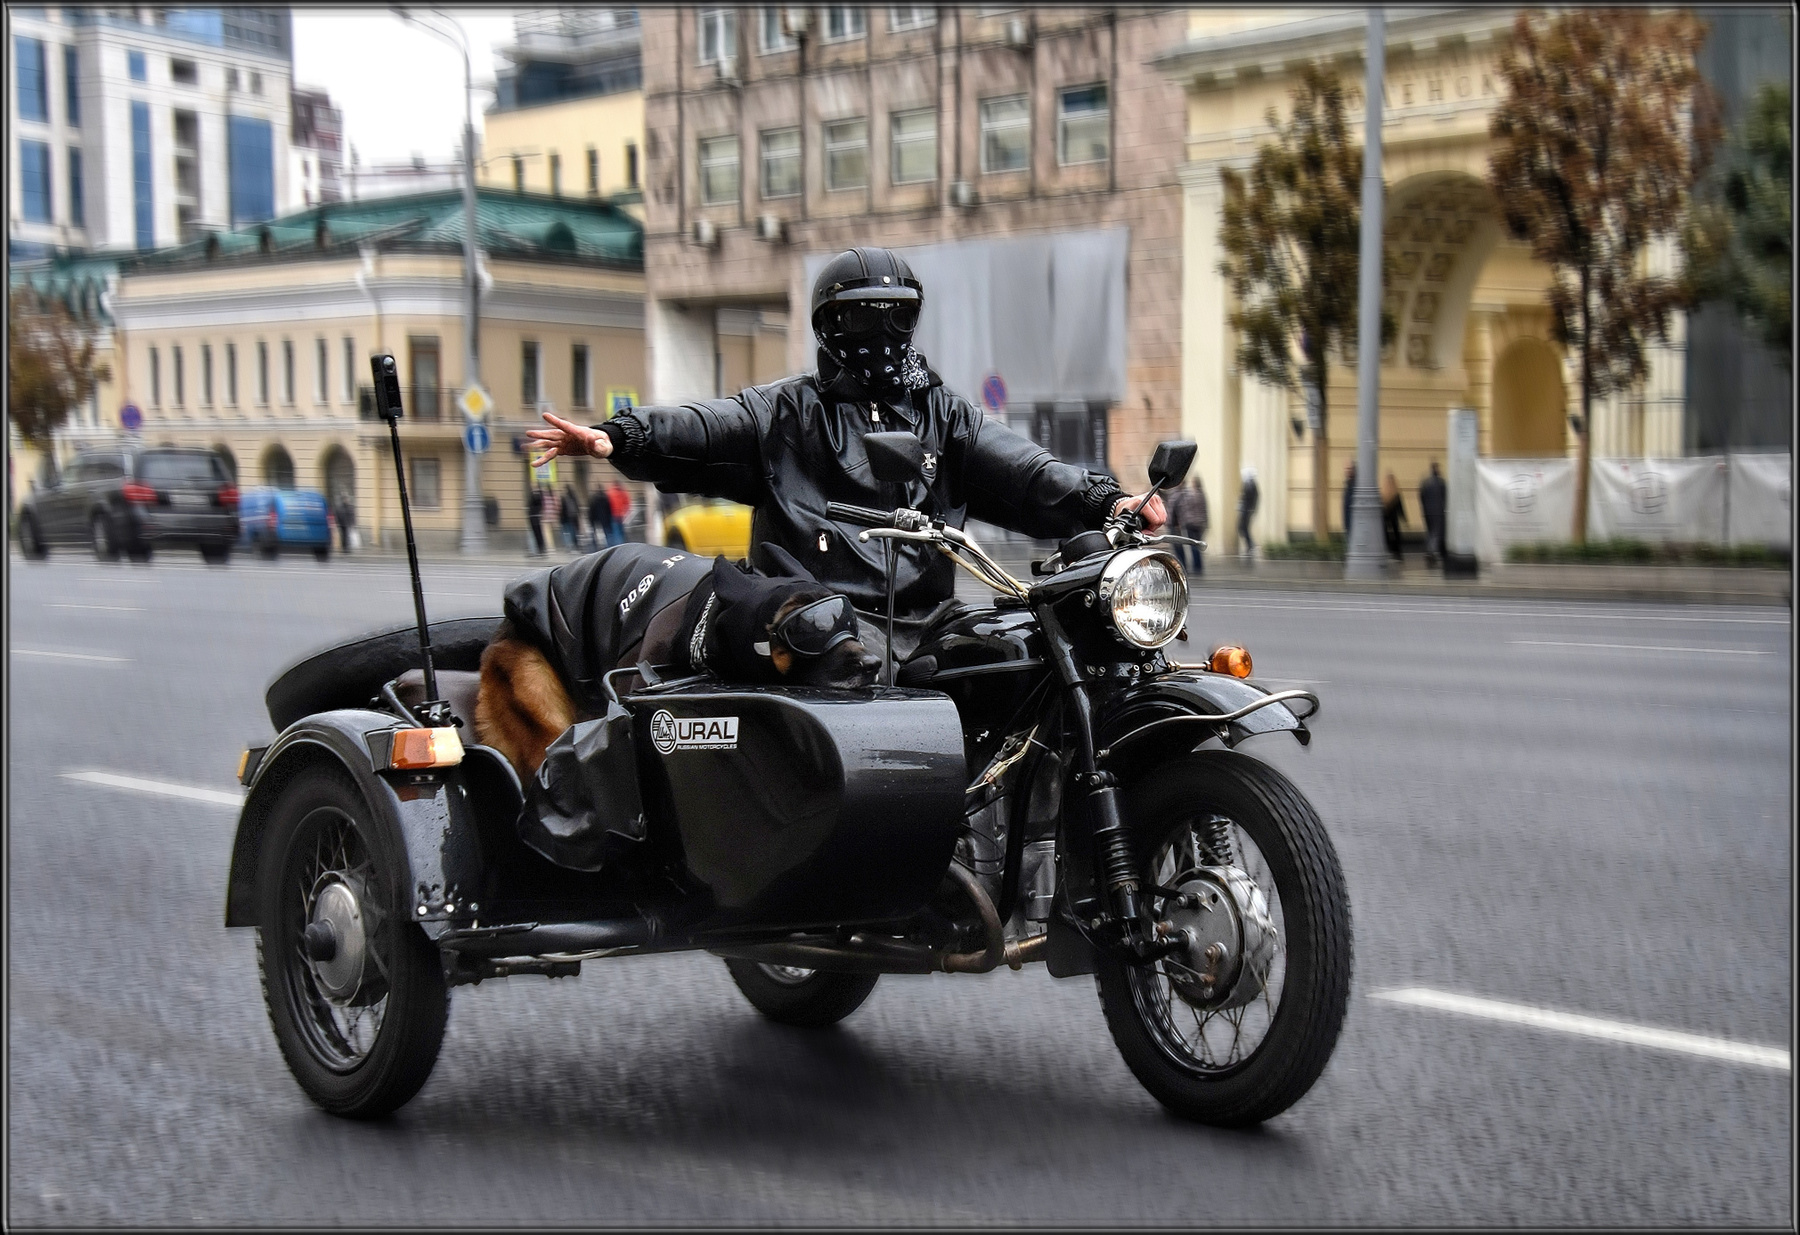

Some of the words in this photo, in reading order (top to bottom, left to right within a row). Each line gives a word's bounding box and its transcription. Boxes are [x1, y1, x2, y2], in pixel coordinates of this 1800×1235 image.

[662, 554, 686, 569] of
[619, 574, 655, 614] God
[678, 721, 735, 740] URAL
